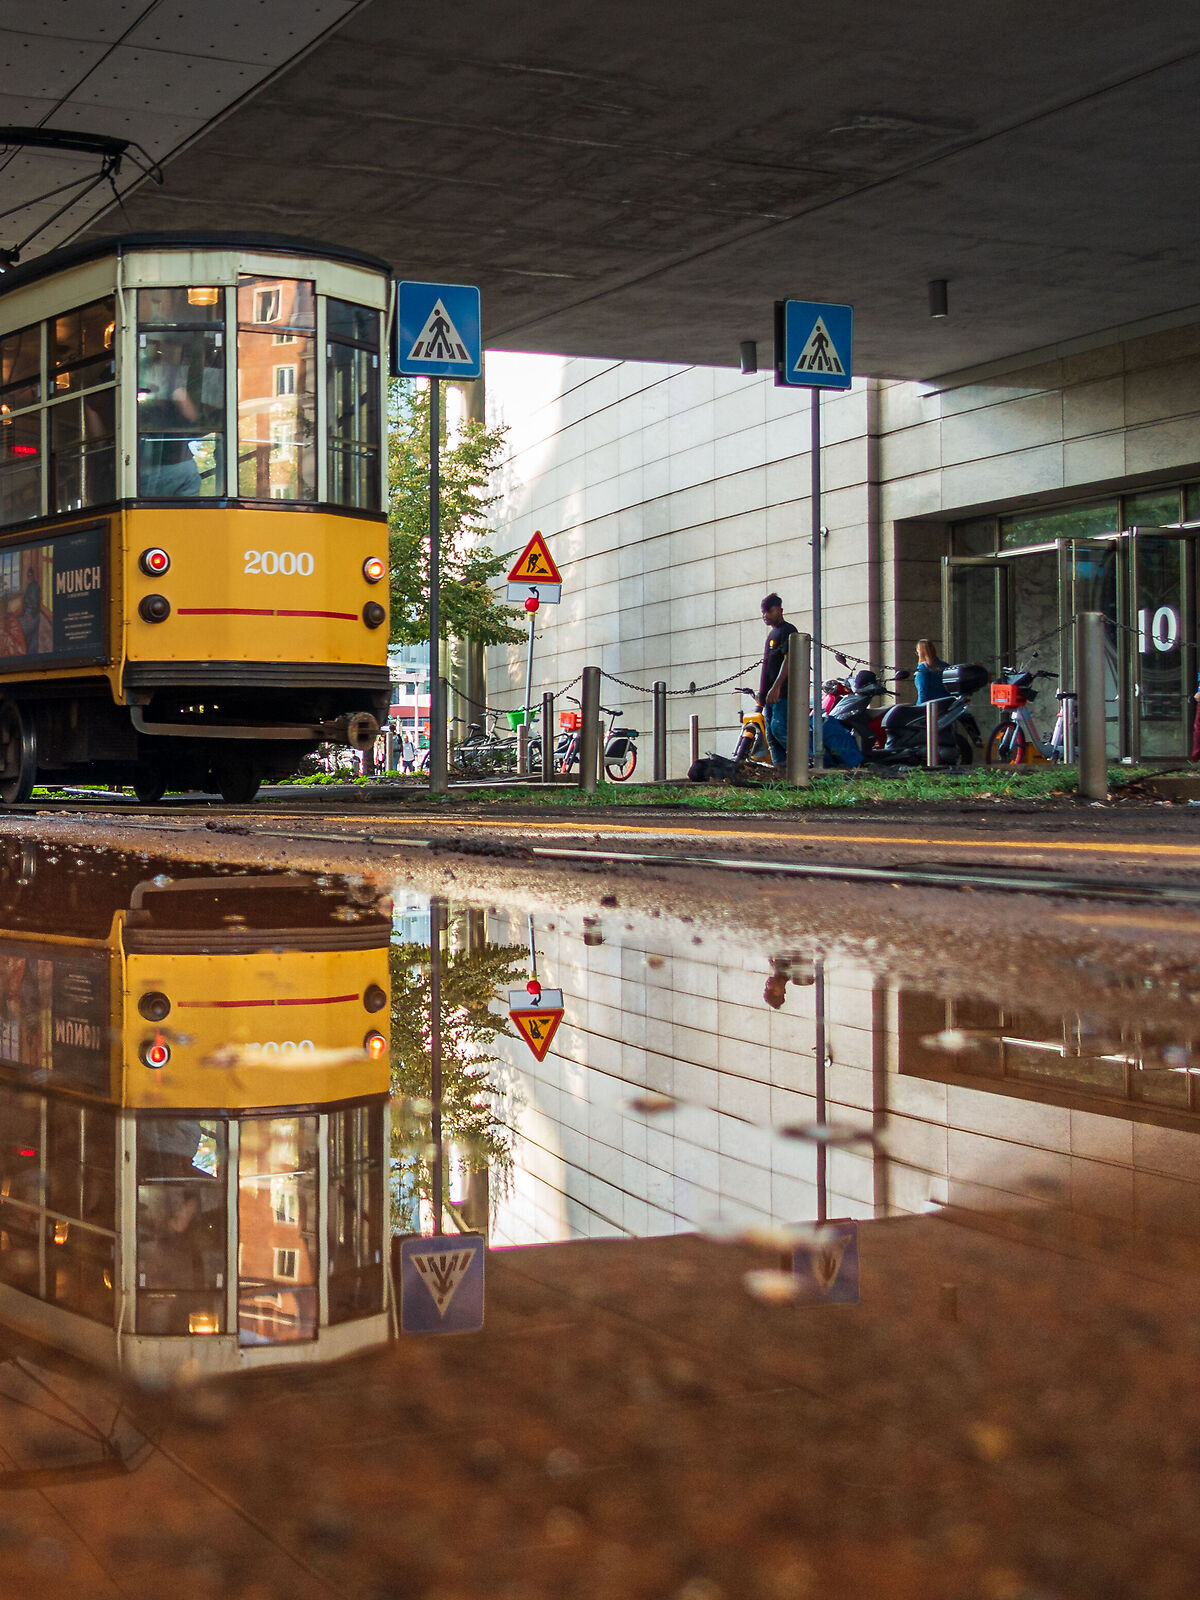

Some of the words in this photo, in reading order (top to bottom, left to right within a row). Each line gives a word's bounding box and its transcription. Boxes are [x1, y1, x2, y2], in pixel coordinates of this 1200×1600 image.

[244, 550, 314, 576] 2000
[56, 566, 100, 595] MUNCH
[1138, 606, 1177, 652] 10
